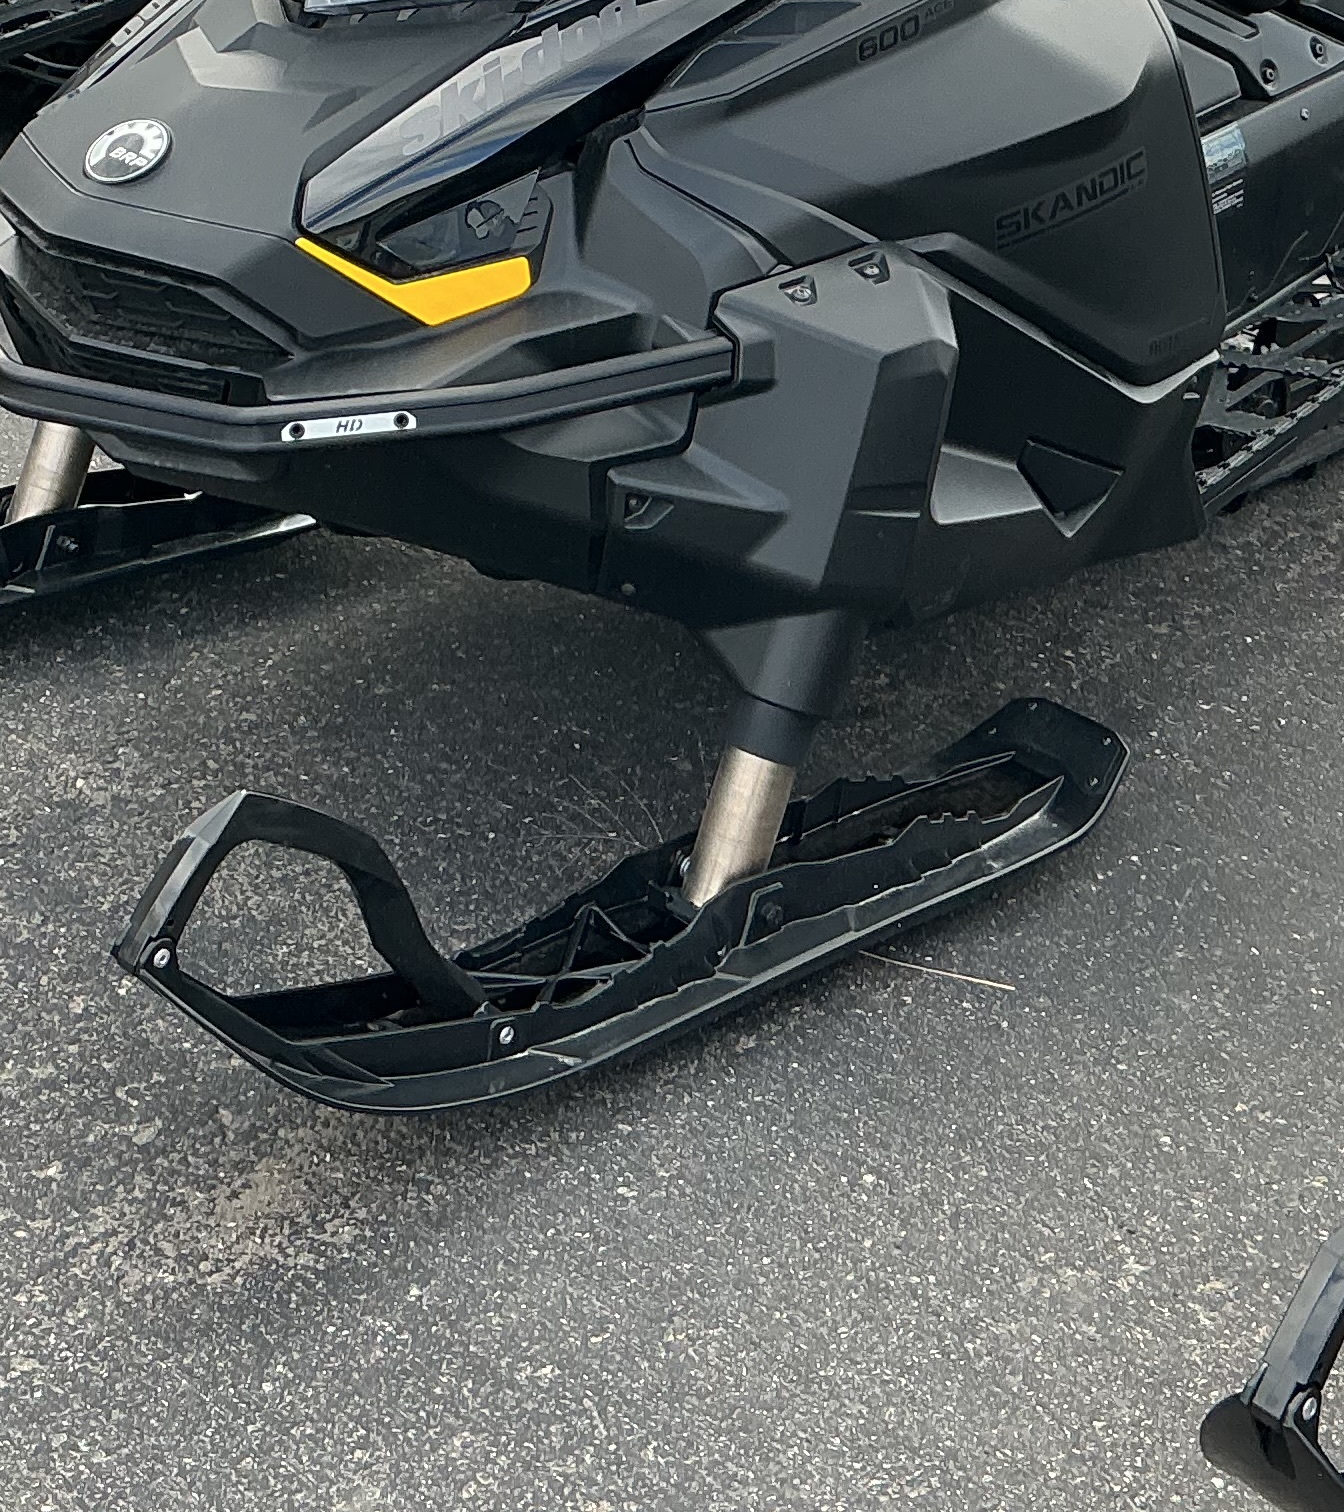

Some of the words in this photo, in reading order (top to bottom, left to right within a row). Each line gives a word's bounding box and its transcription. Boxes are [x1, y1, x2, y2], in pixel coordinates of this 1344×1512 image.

[859, 14, 920, 62] 600
[108, 146, 149, 167] BRP
[996, 150, 1146, 242] SKANDIC
[335, 418, 364, 434] HD
